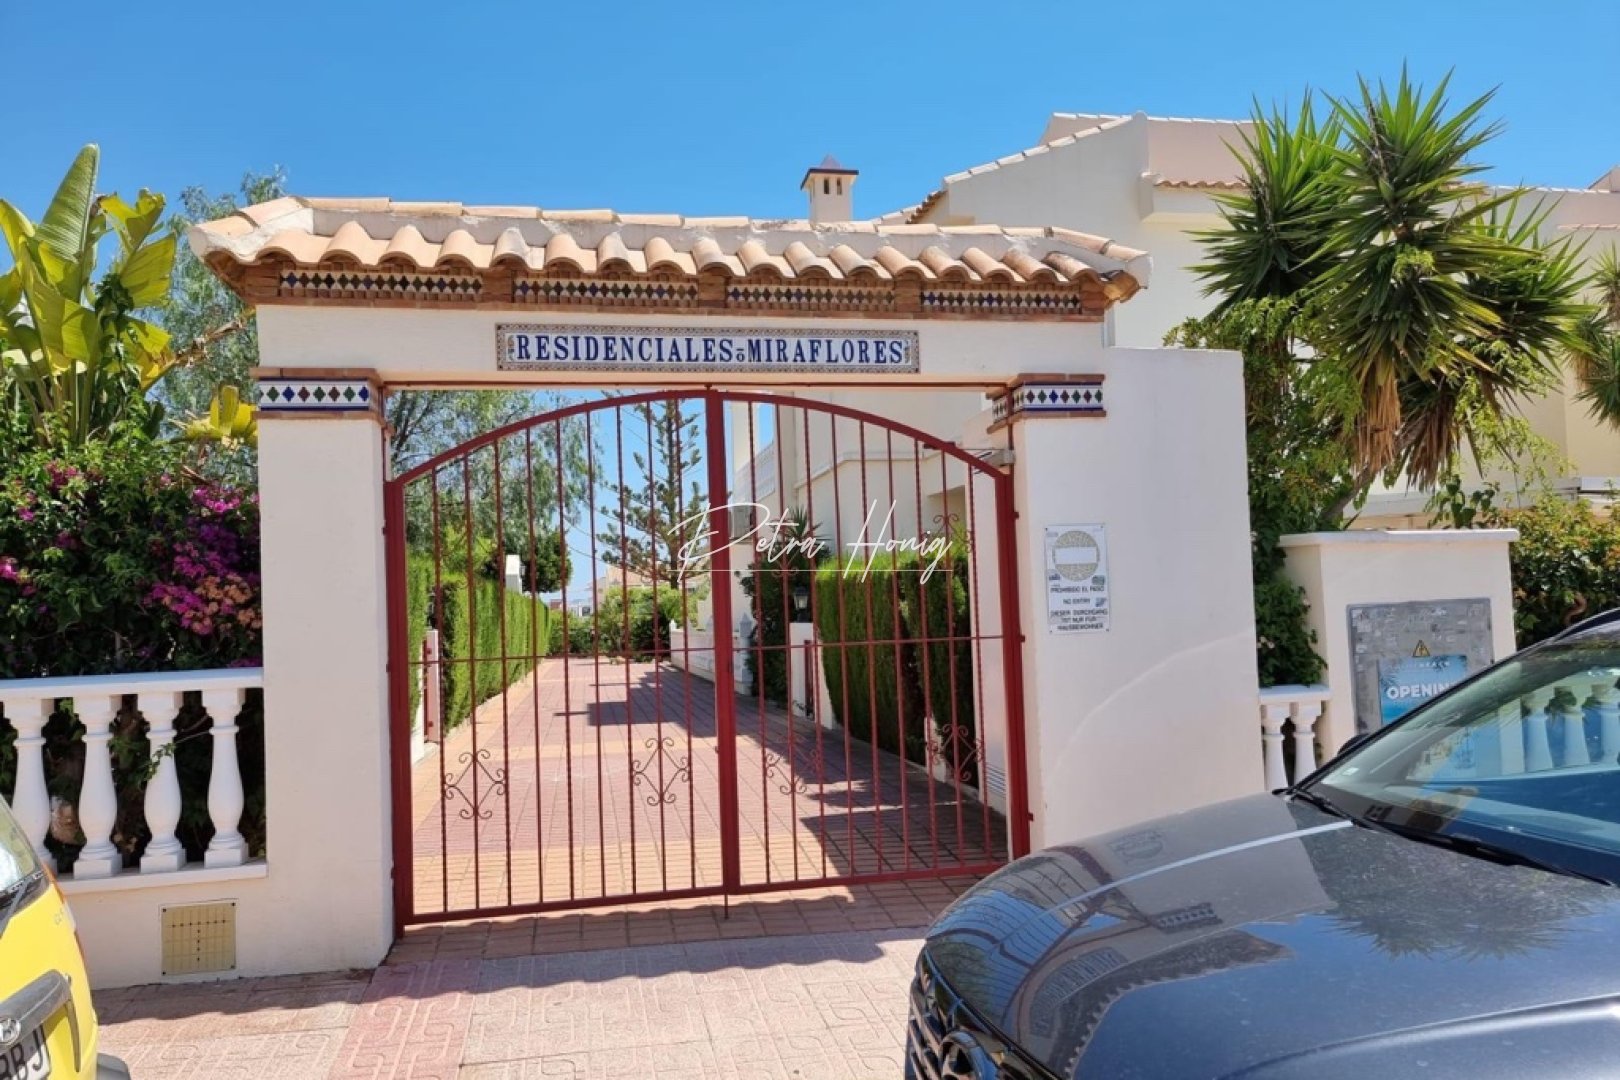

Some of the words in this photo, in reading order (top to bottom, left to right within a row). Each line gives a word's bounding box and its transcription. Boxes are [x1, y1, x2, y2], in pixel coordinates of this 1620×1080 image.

[515, 335, 733, 363] RESIDENCIALES
[747, 338, 903, 364] MIRAFLORES
[1386, 683, 1450, 699] OPENIN
